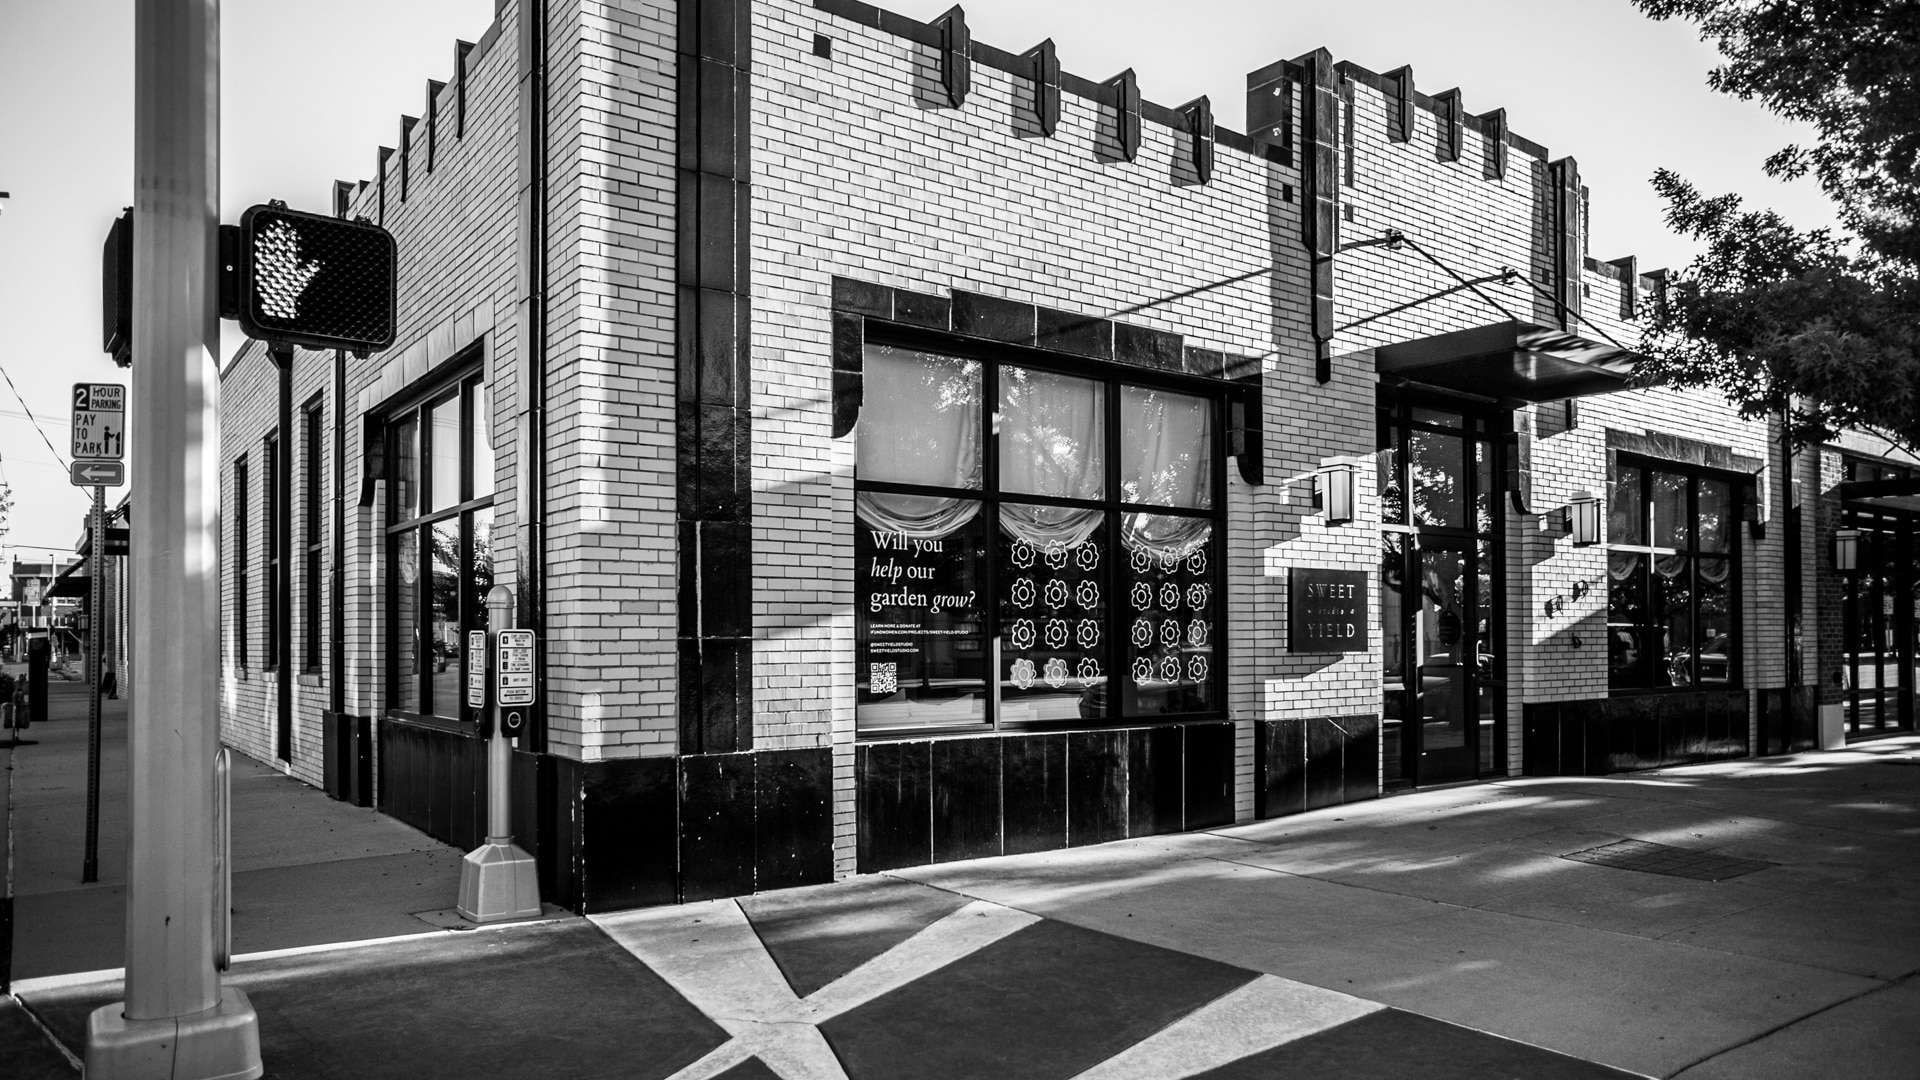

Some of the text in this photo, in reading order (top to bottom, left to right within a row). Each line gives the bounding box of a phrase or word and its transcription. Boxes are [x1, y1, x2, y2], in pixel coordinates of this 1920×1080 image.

[76, 387, 121, 407] 2 HOUR
[91, 399, 121, 409] PARKING
[76, 413, 96, 426] PAY
[76, 427, 88, 440] TO
[75, 441, 102, 454] PARK
[870, 530, 943, 558] Will you
[870, 556, 936, 585] help our
[1307, 583, 1355, 599] SWEET
[870, 586, 976, 614] garden grow?
[1307, 623, 1355, 638] YIELD
